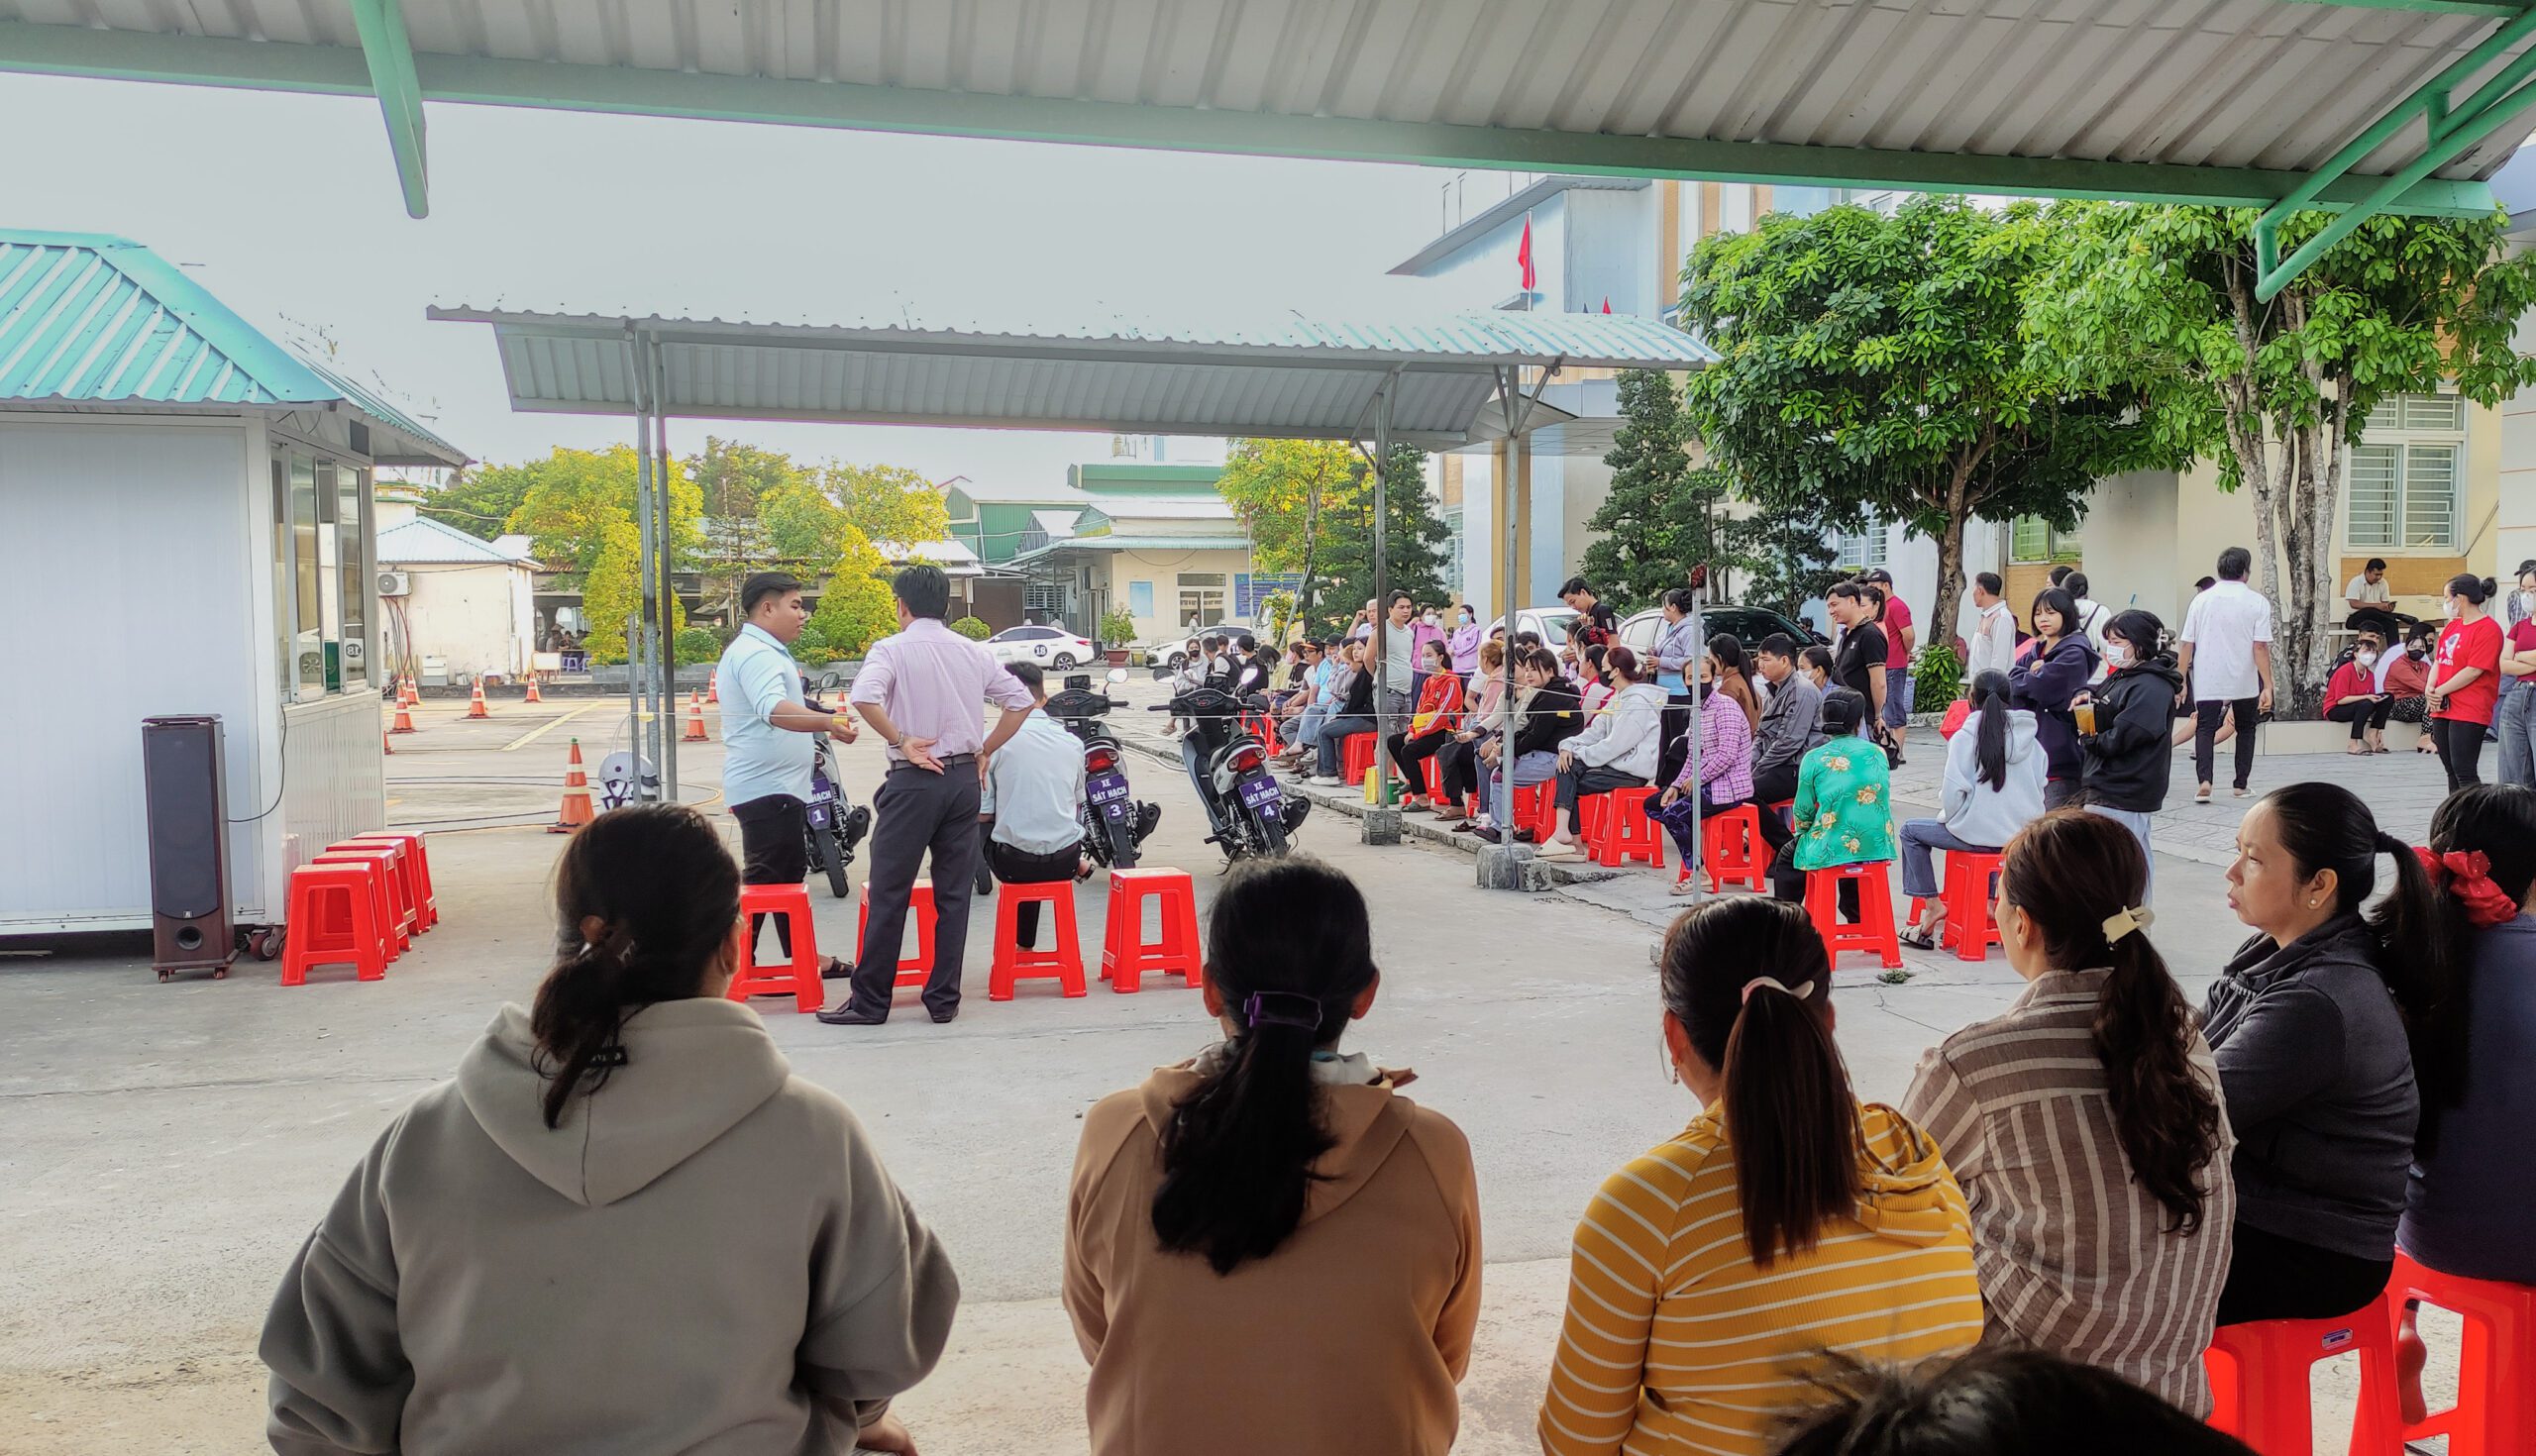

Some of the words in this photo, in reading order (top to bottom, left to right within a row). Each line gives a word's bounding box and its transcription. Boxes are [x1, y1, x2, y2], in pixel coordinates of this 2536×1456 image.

[1036, 646, 1046, 655] 18
[1101, 778, 1112, 788] XE
[1253, 780, 1265, 791] XE
[1092, 789, 1107, 802] SÁT
[1245, 792, 1259, 805] SÁT
[813, 808, 825, 822] 1
[1110, 803, 1122, 817] 3
[1264, 804, 1275, 817] 4
